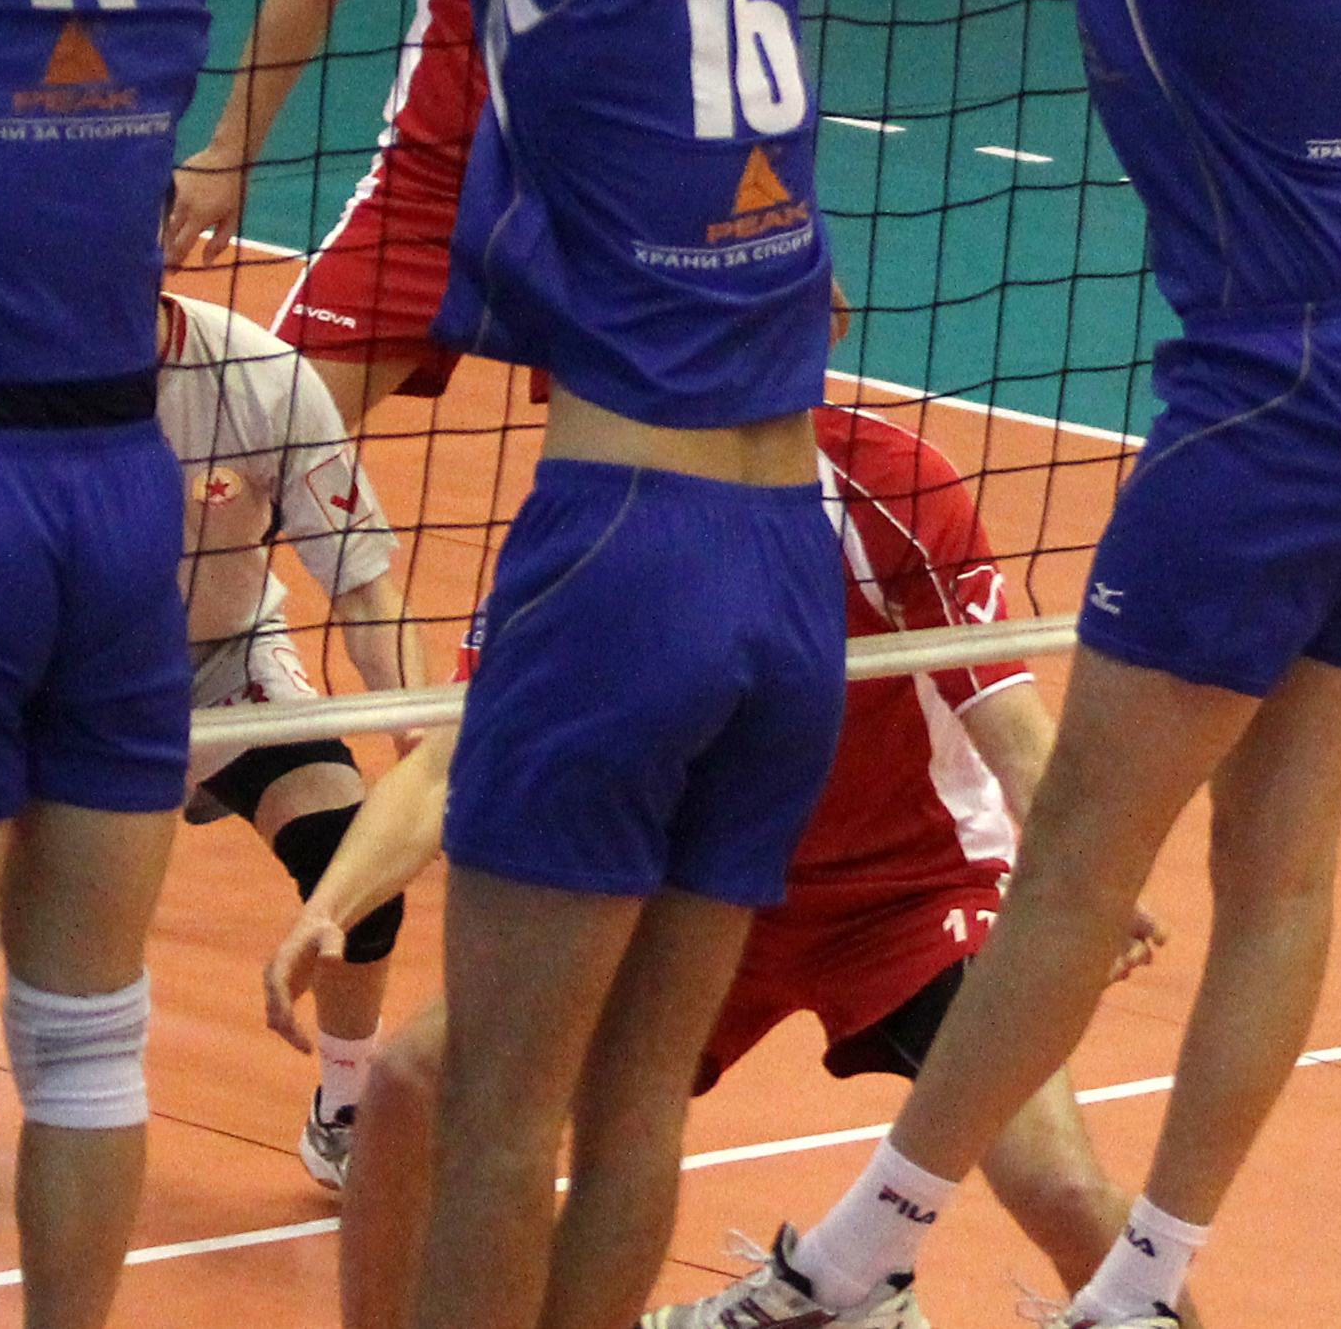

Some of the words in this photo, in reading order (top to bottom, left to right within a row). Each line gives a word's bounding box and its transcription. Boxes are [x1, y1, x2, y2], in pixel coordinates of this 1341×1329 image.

[635, 247, 720, 270] ХРАНИ
[723, 249, 749, 268] ЗА
[878, 1183, 937, 1225] FILA
